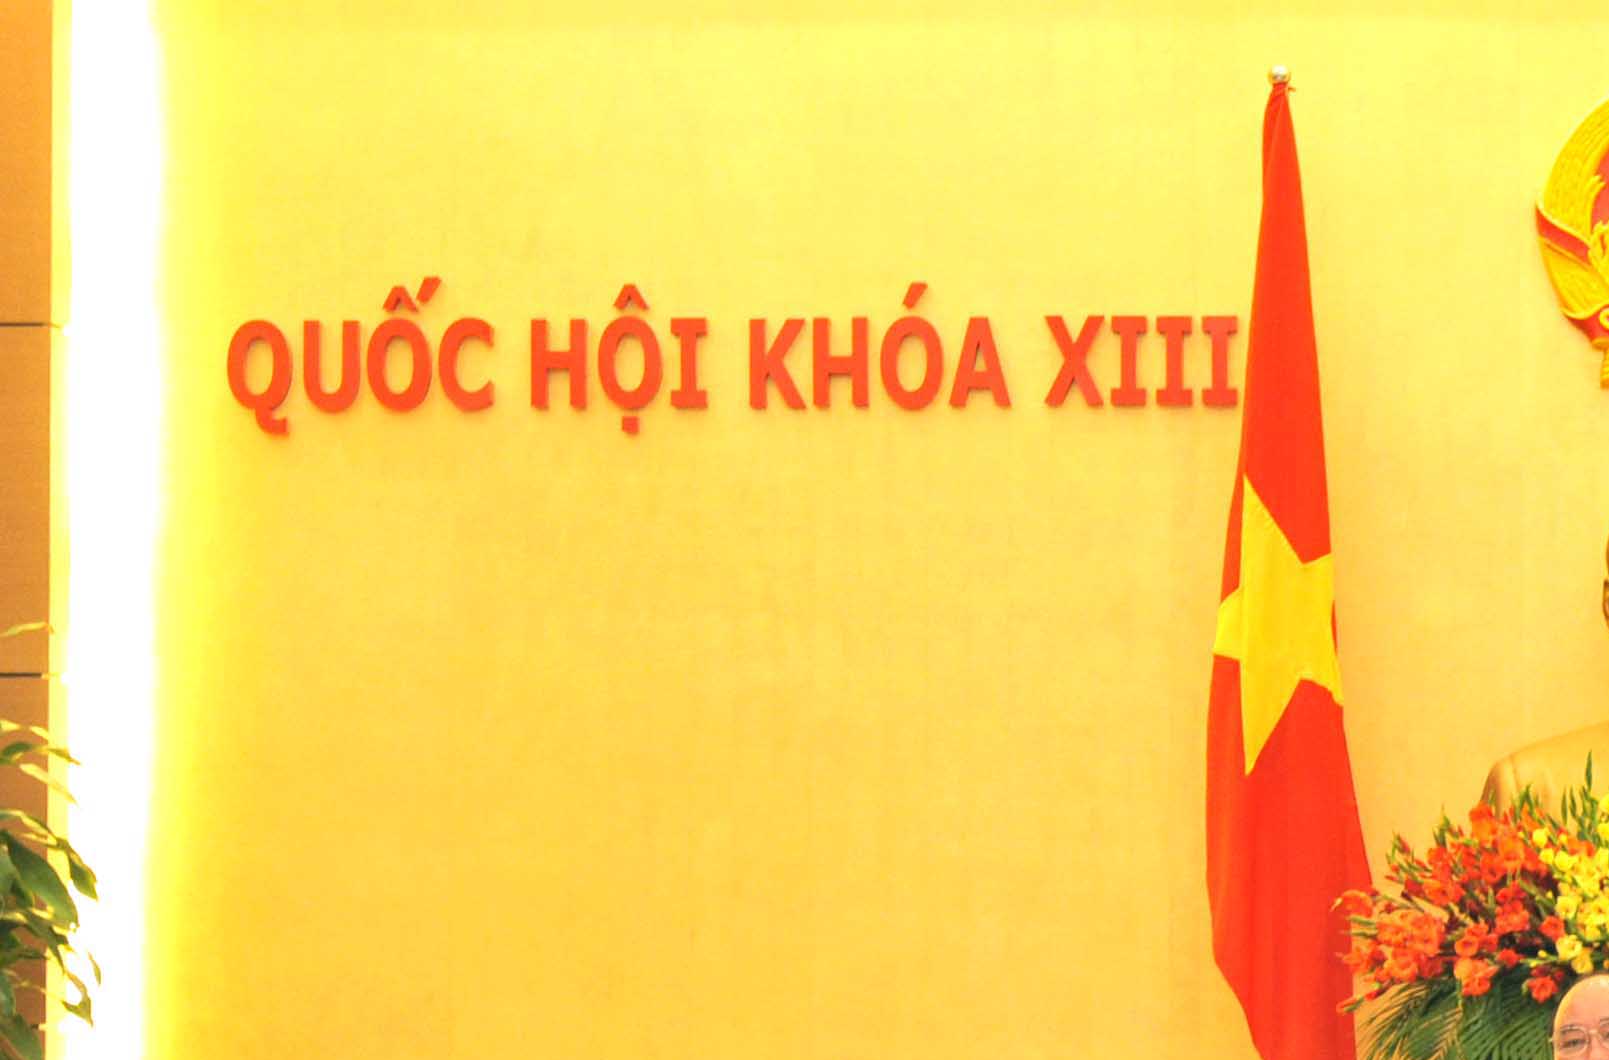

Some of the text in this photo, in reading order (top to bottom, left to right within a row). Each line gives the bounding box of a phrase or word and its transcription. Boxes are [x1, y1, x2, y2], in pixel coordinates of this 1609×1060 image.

[227, 277, 1239, 437] QUỐC HỘI KHÓA XIII
